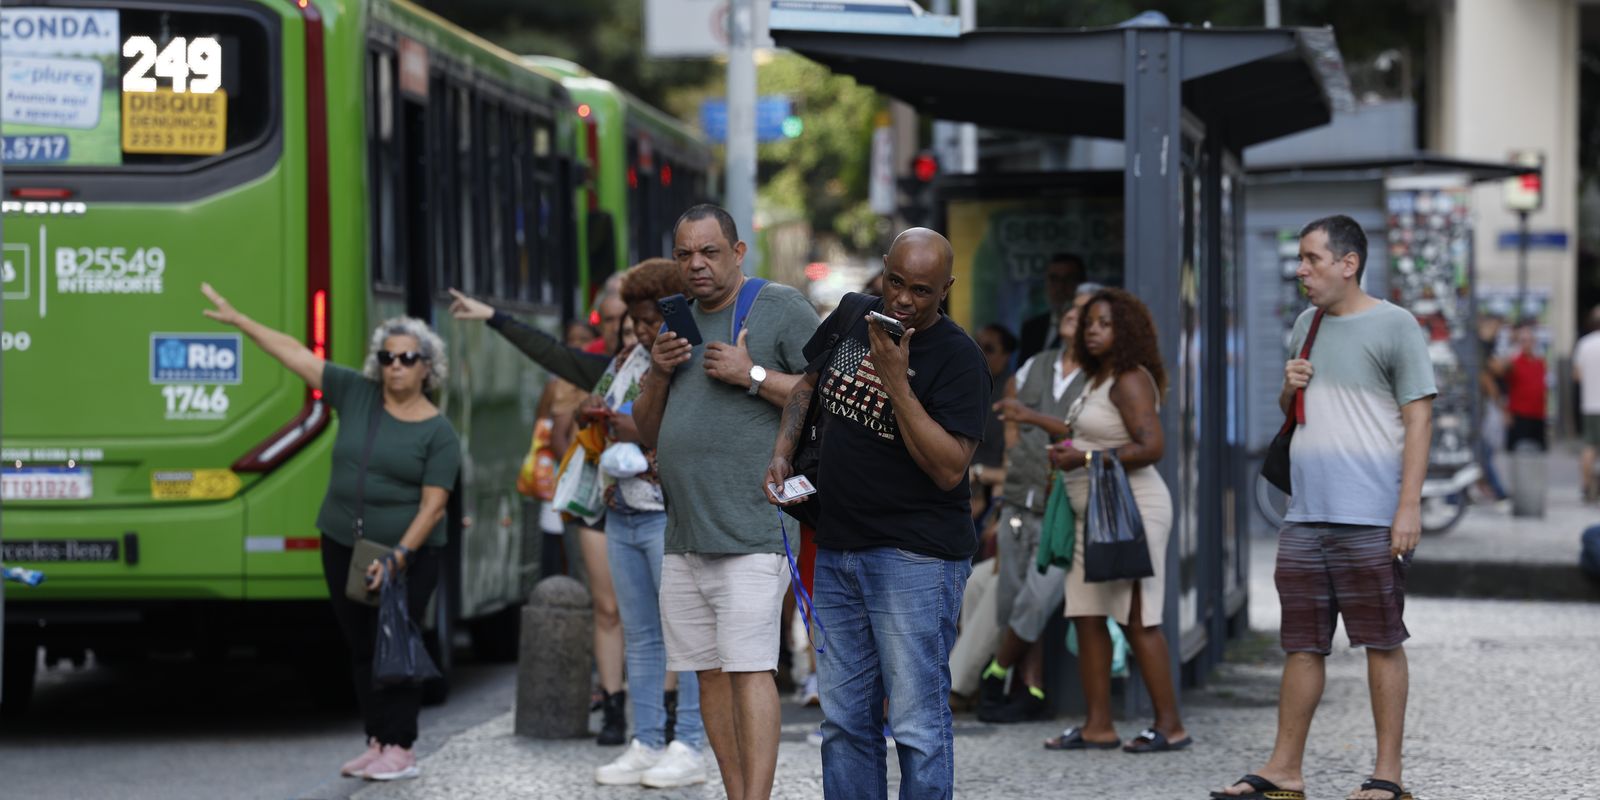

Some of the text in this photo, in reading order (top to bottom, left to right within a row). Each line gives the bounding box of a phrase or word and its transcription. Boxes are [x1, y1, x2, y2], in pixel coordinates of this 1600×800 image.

[122, 36, 222, 94] 249
[130, 94, 217, 114] DISQUE
[55, 247, 166, 277] B25549
[57, 276, 164, 294] INTERNORTE
[188, 344, 235, 369] Rio
[161, 385, 229, 413] 1746
